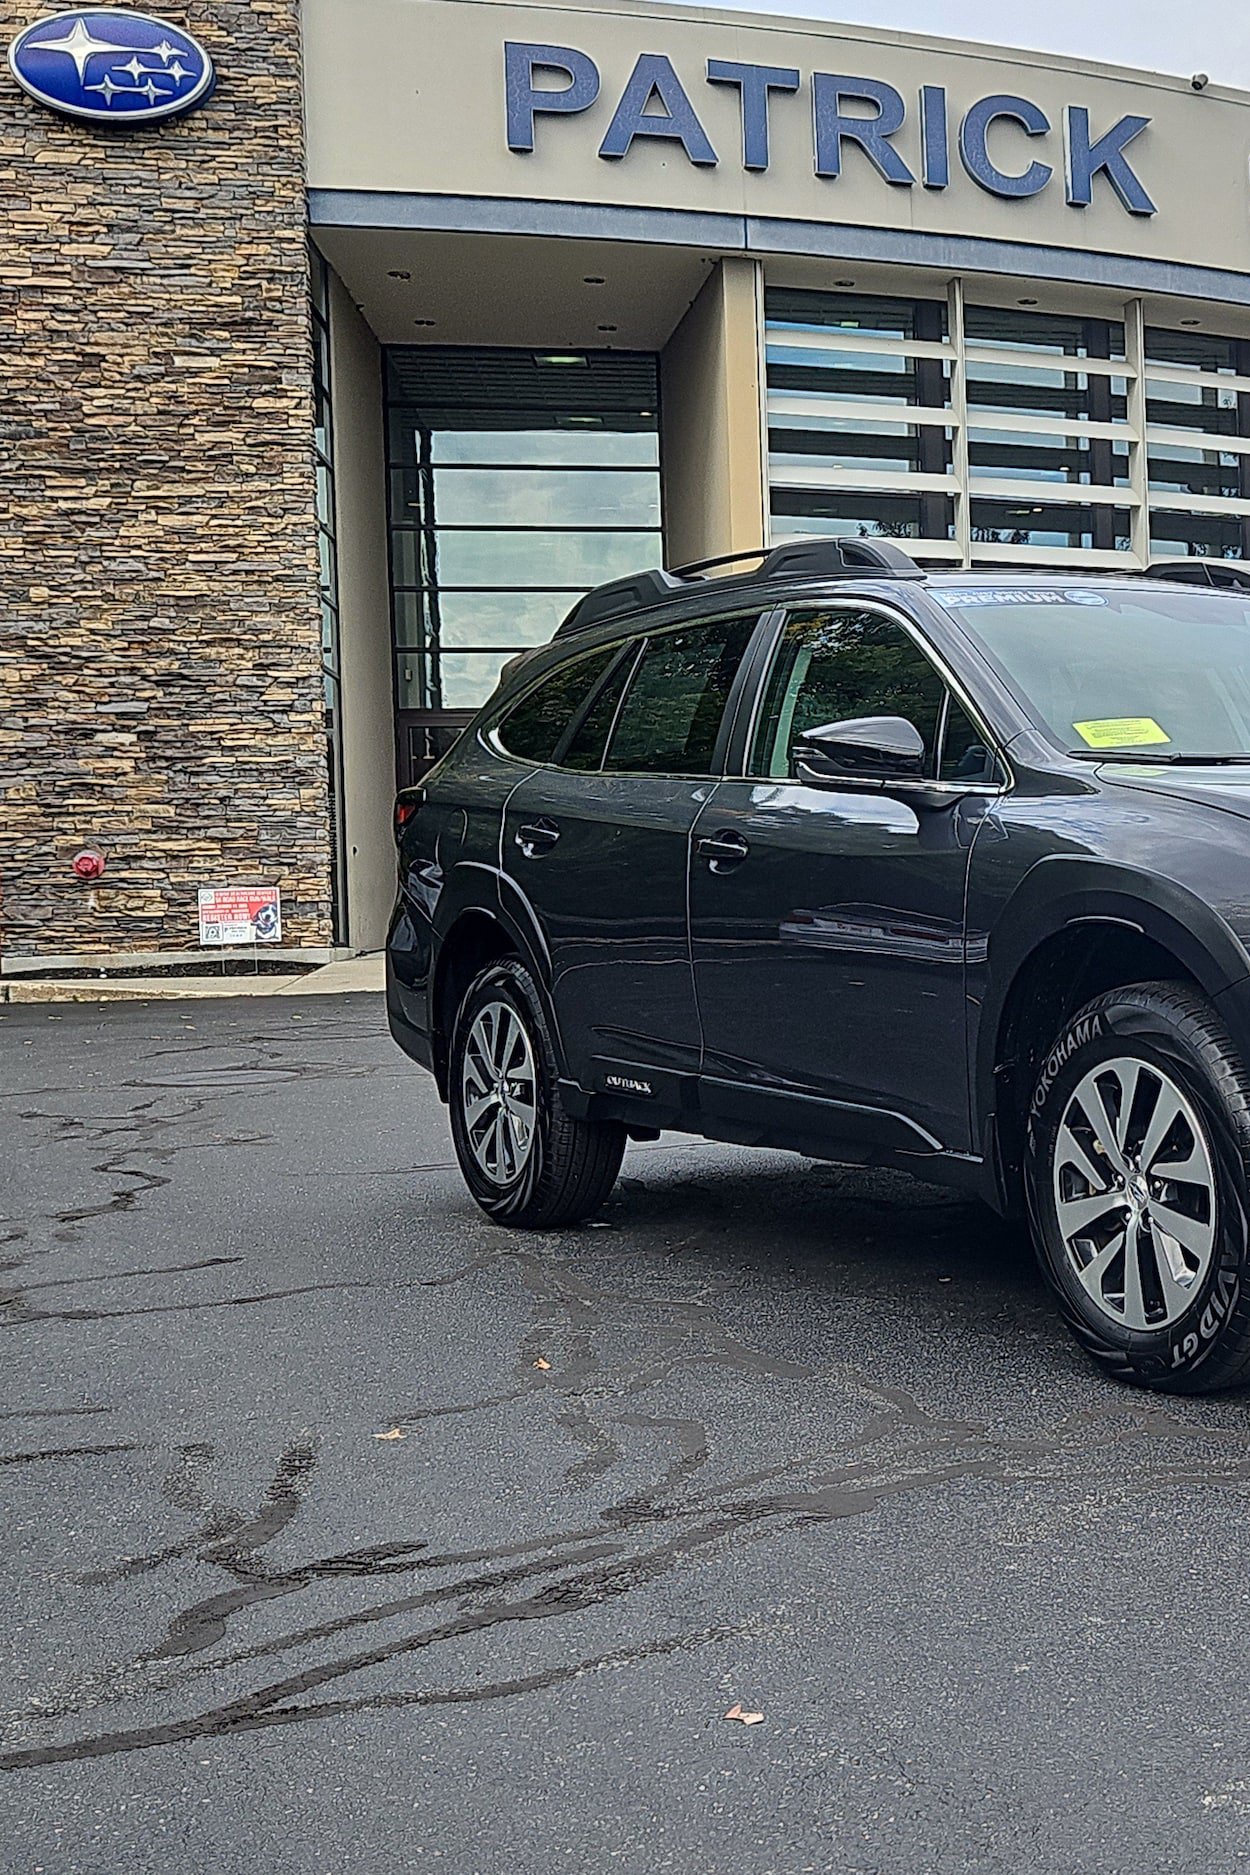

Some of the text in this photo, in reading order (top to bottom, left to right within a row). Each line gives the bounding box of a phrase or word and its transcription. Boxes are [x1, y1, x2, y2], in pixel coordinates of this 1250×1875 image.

[504, 41, 1158, 217] PATRICK
[943, 591, 1066, 605] PREMIUM
[607, 1075, 652, 1093] OUTBACK
[1031, 1014, 1102, 1117] YOKOHAMA
[1171, 1332, 1199, 1369] GT
